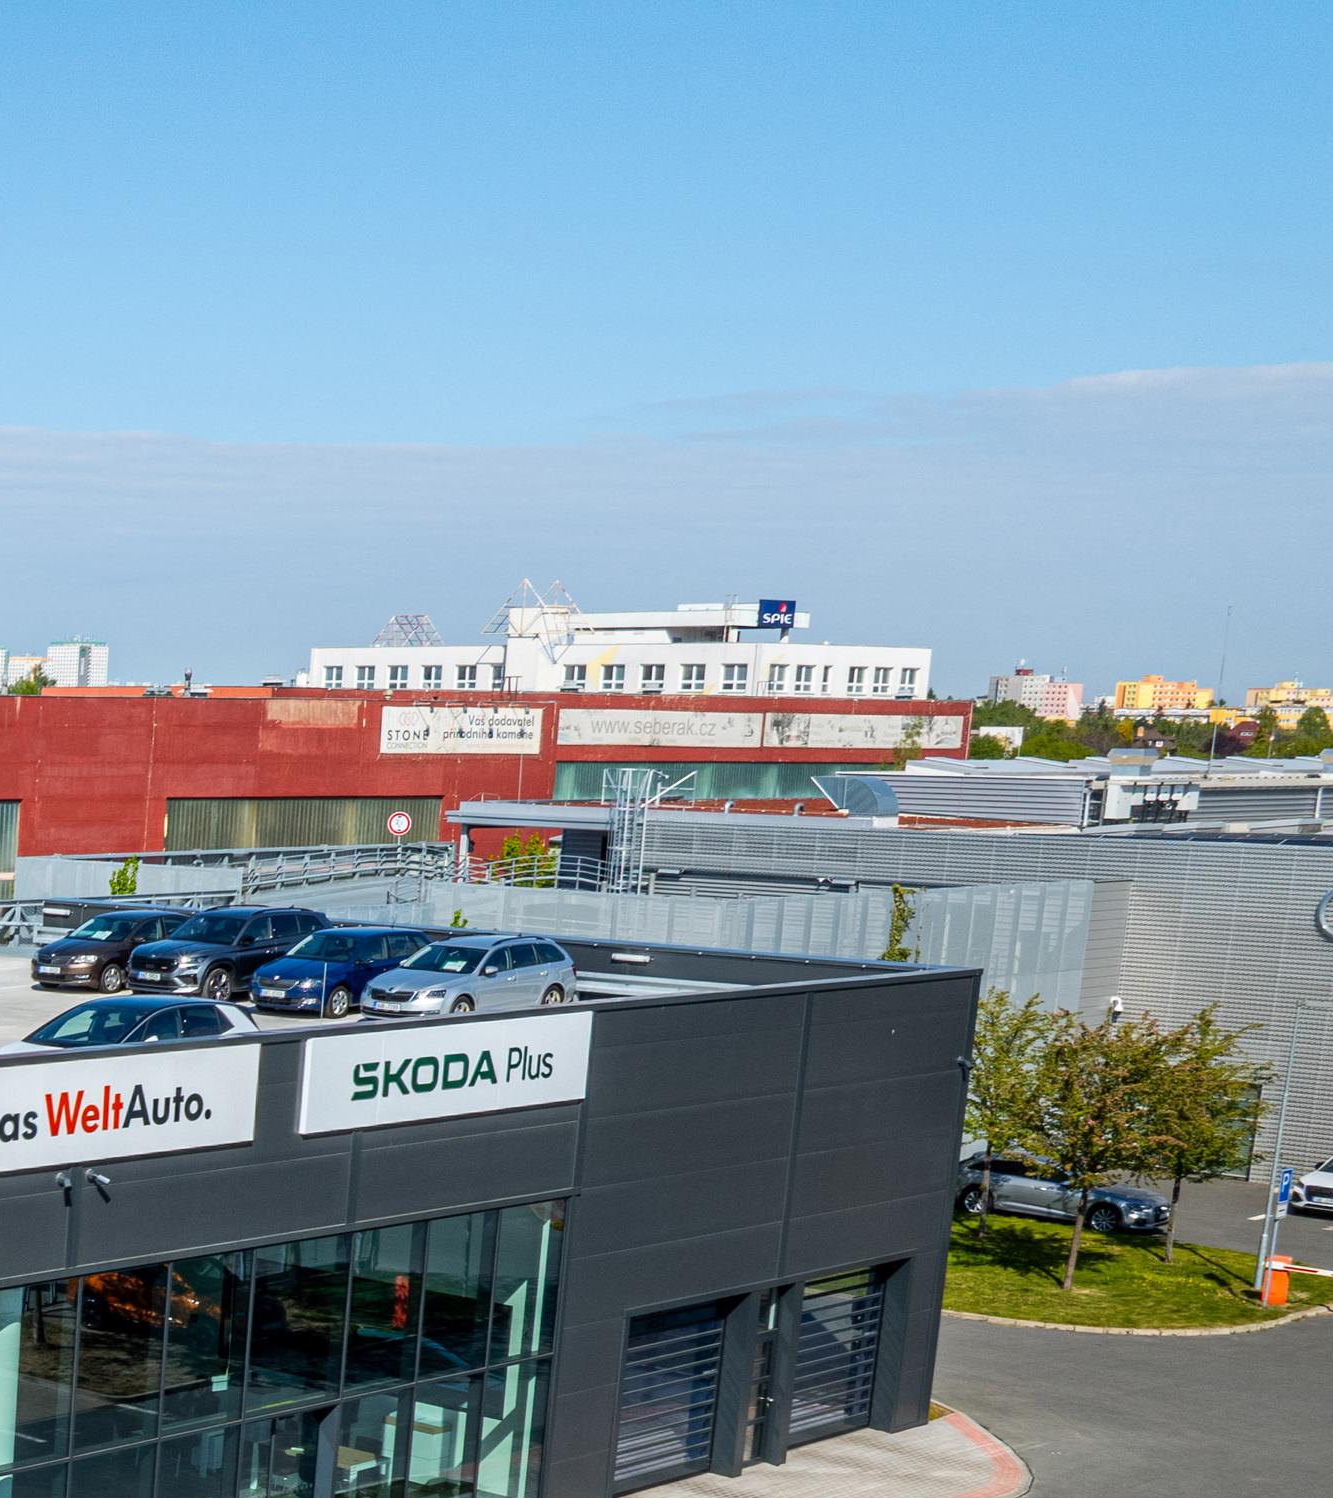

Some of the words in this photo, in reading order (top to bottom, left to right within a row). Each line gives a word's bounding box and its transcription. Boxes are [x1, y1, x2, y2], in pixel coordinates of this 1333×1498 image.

[762, 613, 792, 624] SPIE
[488, 714, 535, 727] dodavatel
[590, 717, 717, 736] www.seberak.cz
[387, 729, 429, 741] STONE
[506, 1046, 554, 1083] Plus
[44, 1083, 213, 1137] WeltAuto.
